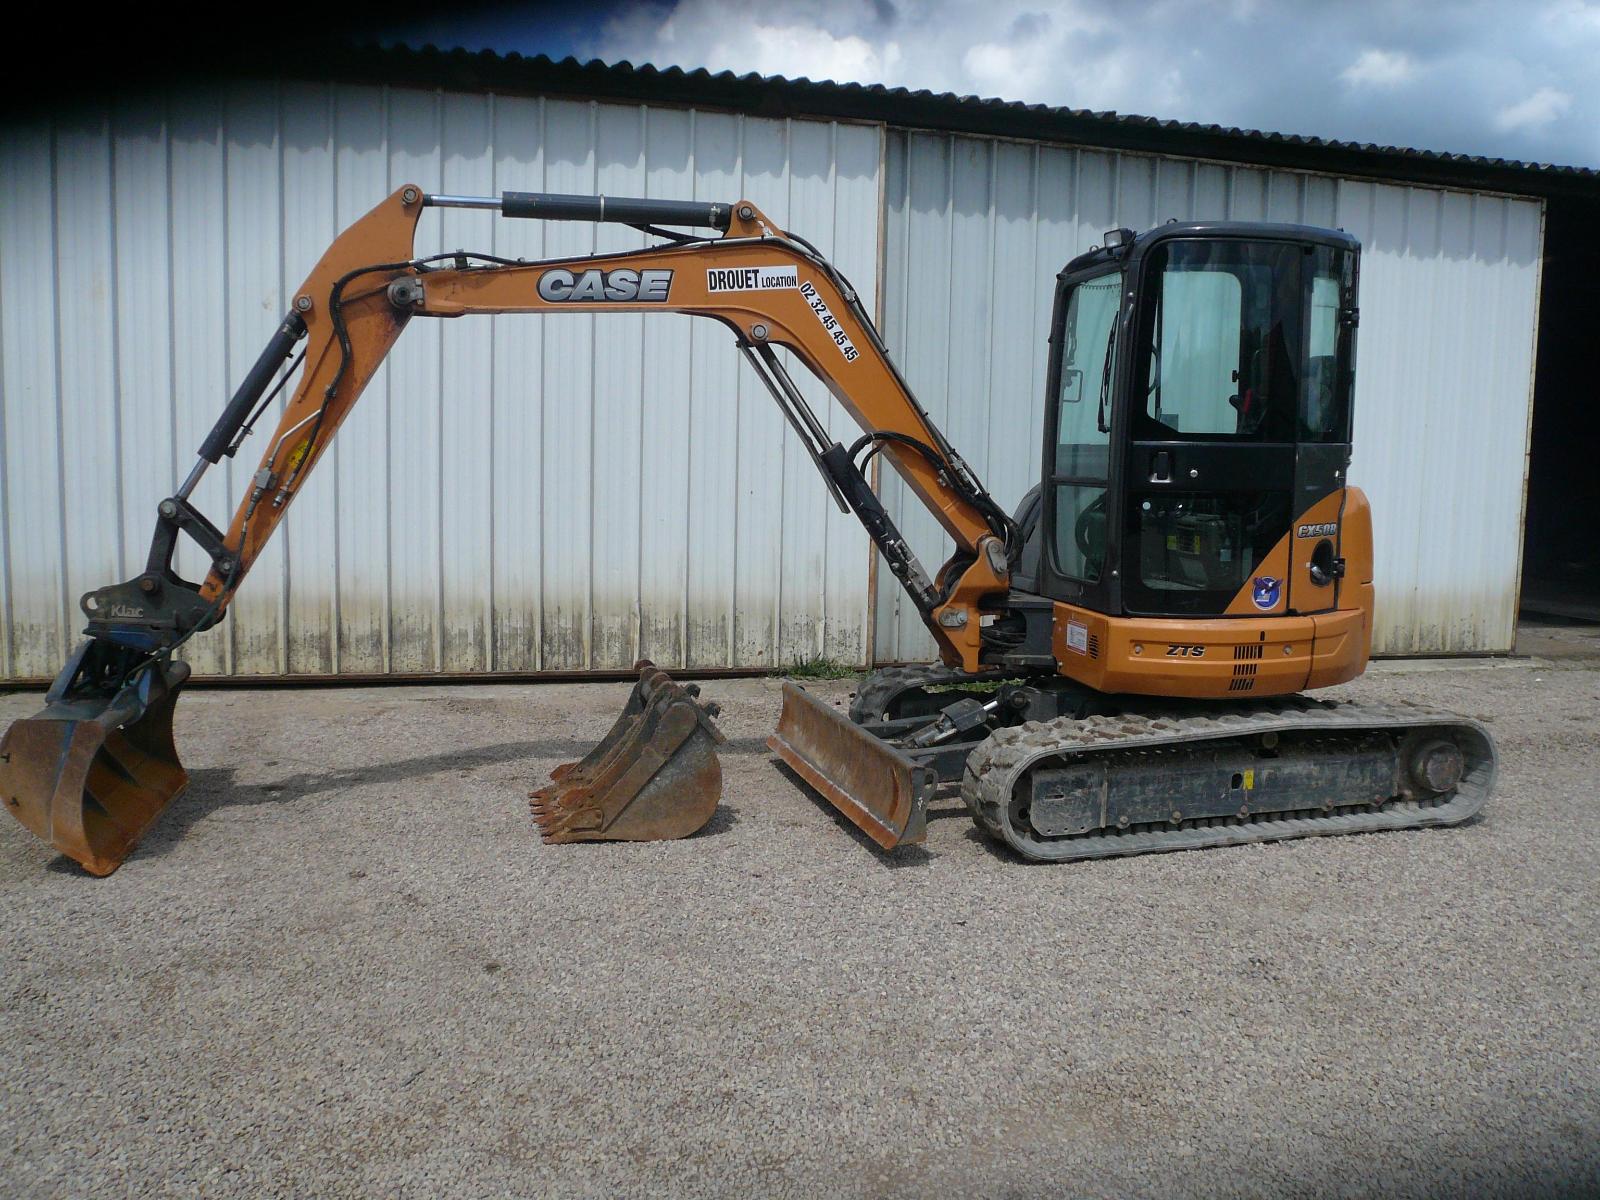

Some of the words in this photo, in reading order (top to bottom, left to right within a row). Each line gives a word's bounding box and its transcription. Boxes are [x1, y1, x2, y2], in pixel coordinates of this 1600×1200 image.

[538, 268, 673, 302] CASE
[708, 269, 760, 290] DROUET
[761, 275, 797, 288] LOCATION
[800, 283, 816, 300] 02
[811, 298, 827, 315] 32
[822, 315, 837, 330] 45
[833, 331, 848, 345] 45
[844, 346, 858, 360] 45
[111, 605, 144, 617] Klac
[1166, 645, 1205, 657] ZTS
